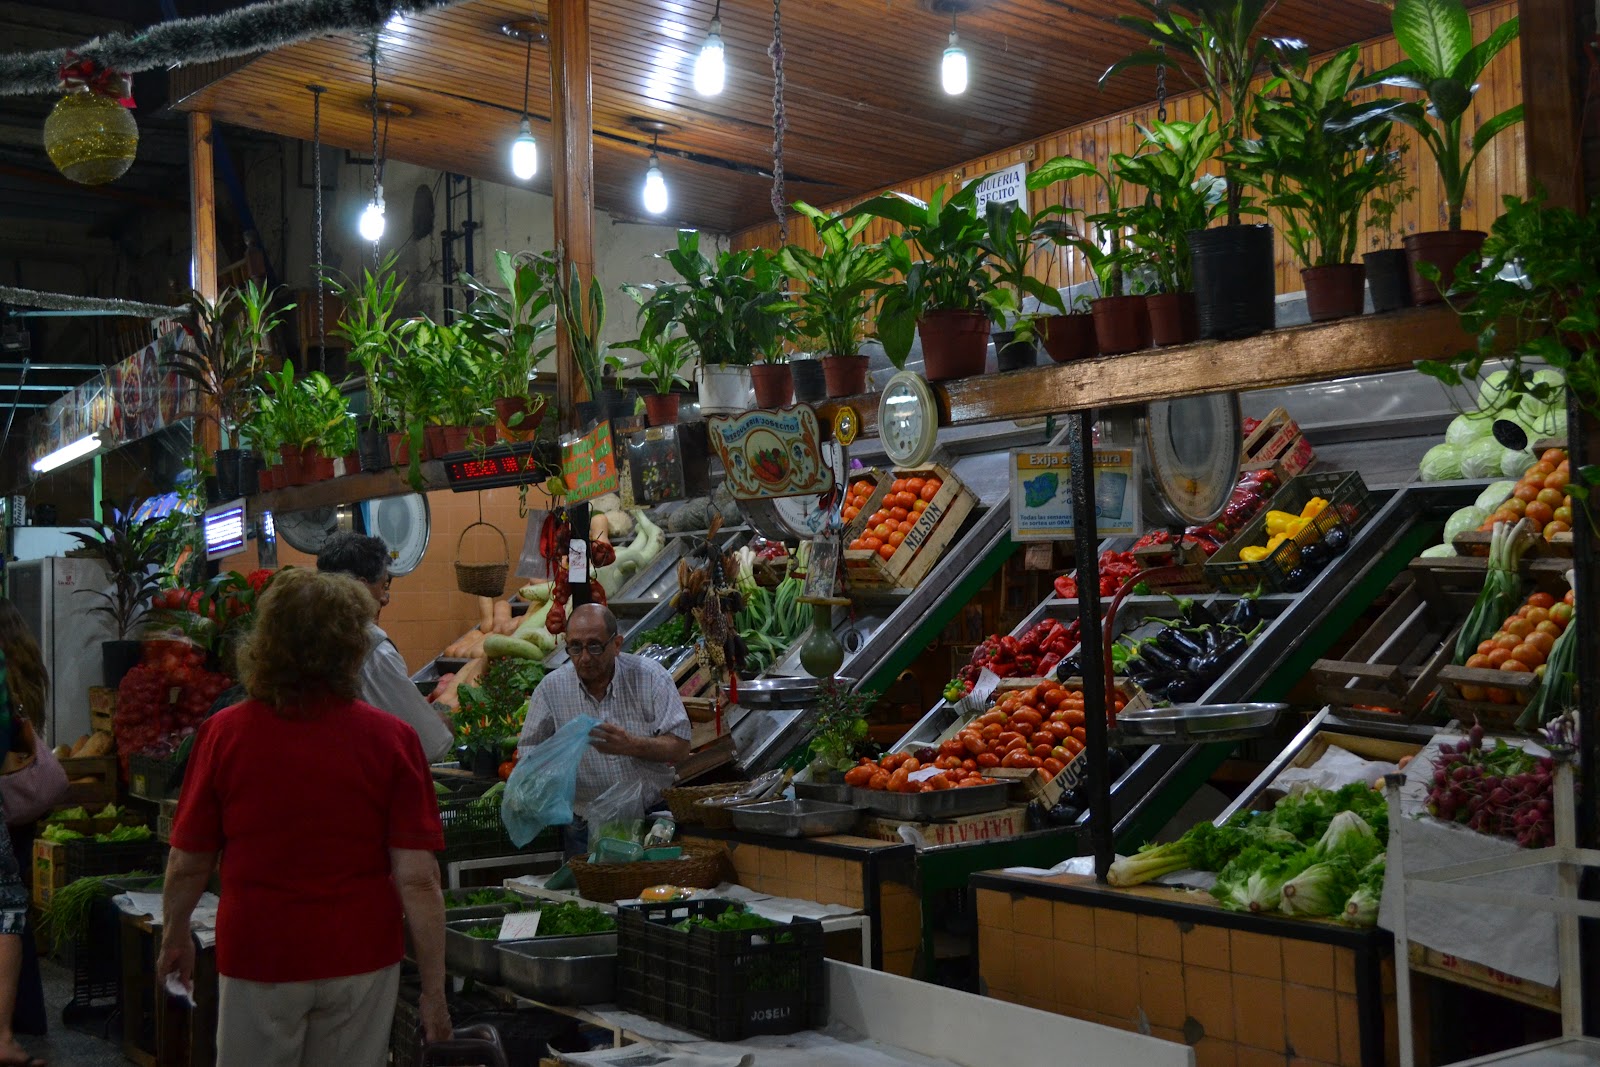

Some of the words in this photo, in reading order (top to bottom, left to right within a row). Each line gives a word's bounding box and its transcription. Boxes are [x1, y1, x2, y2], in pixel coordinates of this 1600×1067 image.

[727, 417, 760, 440] VERDULERIA
[1030, 455, 1058, 467] Exija
[905, 502, 942, 551] NELSON
[751, 1006, 790, 1021] JOSELI
